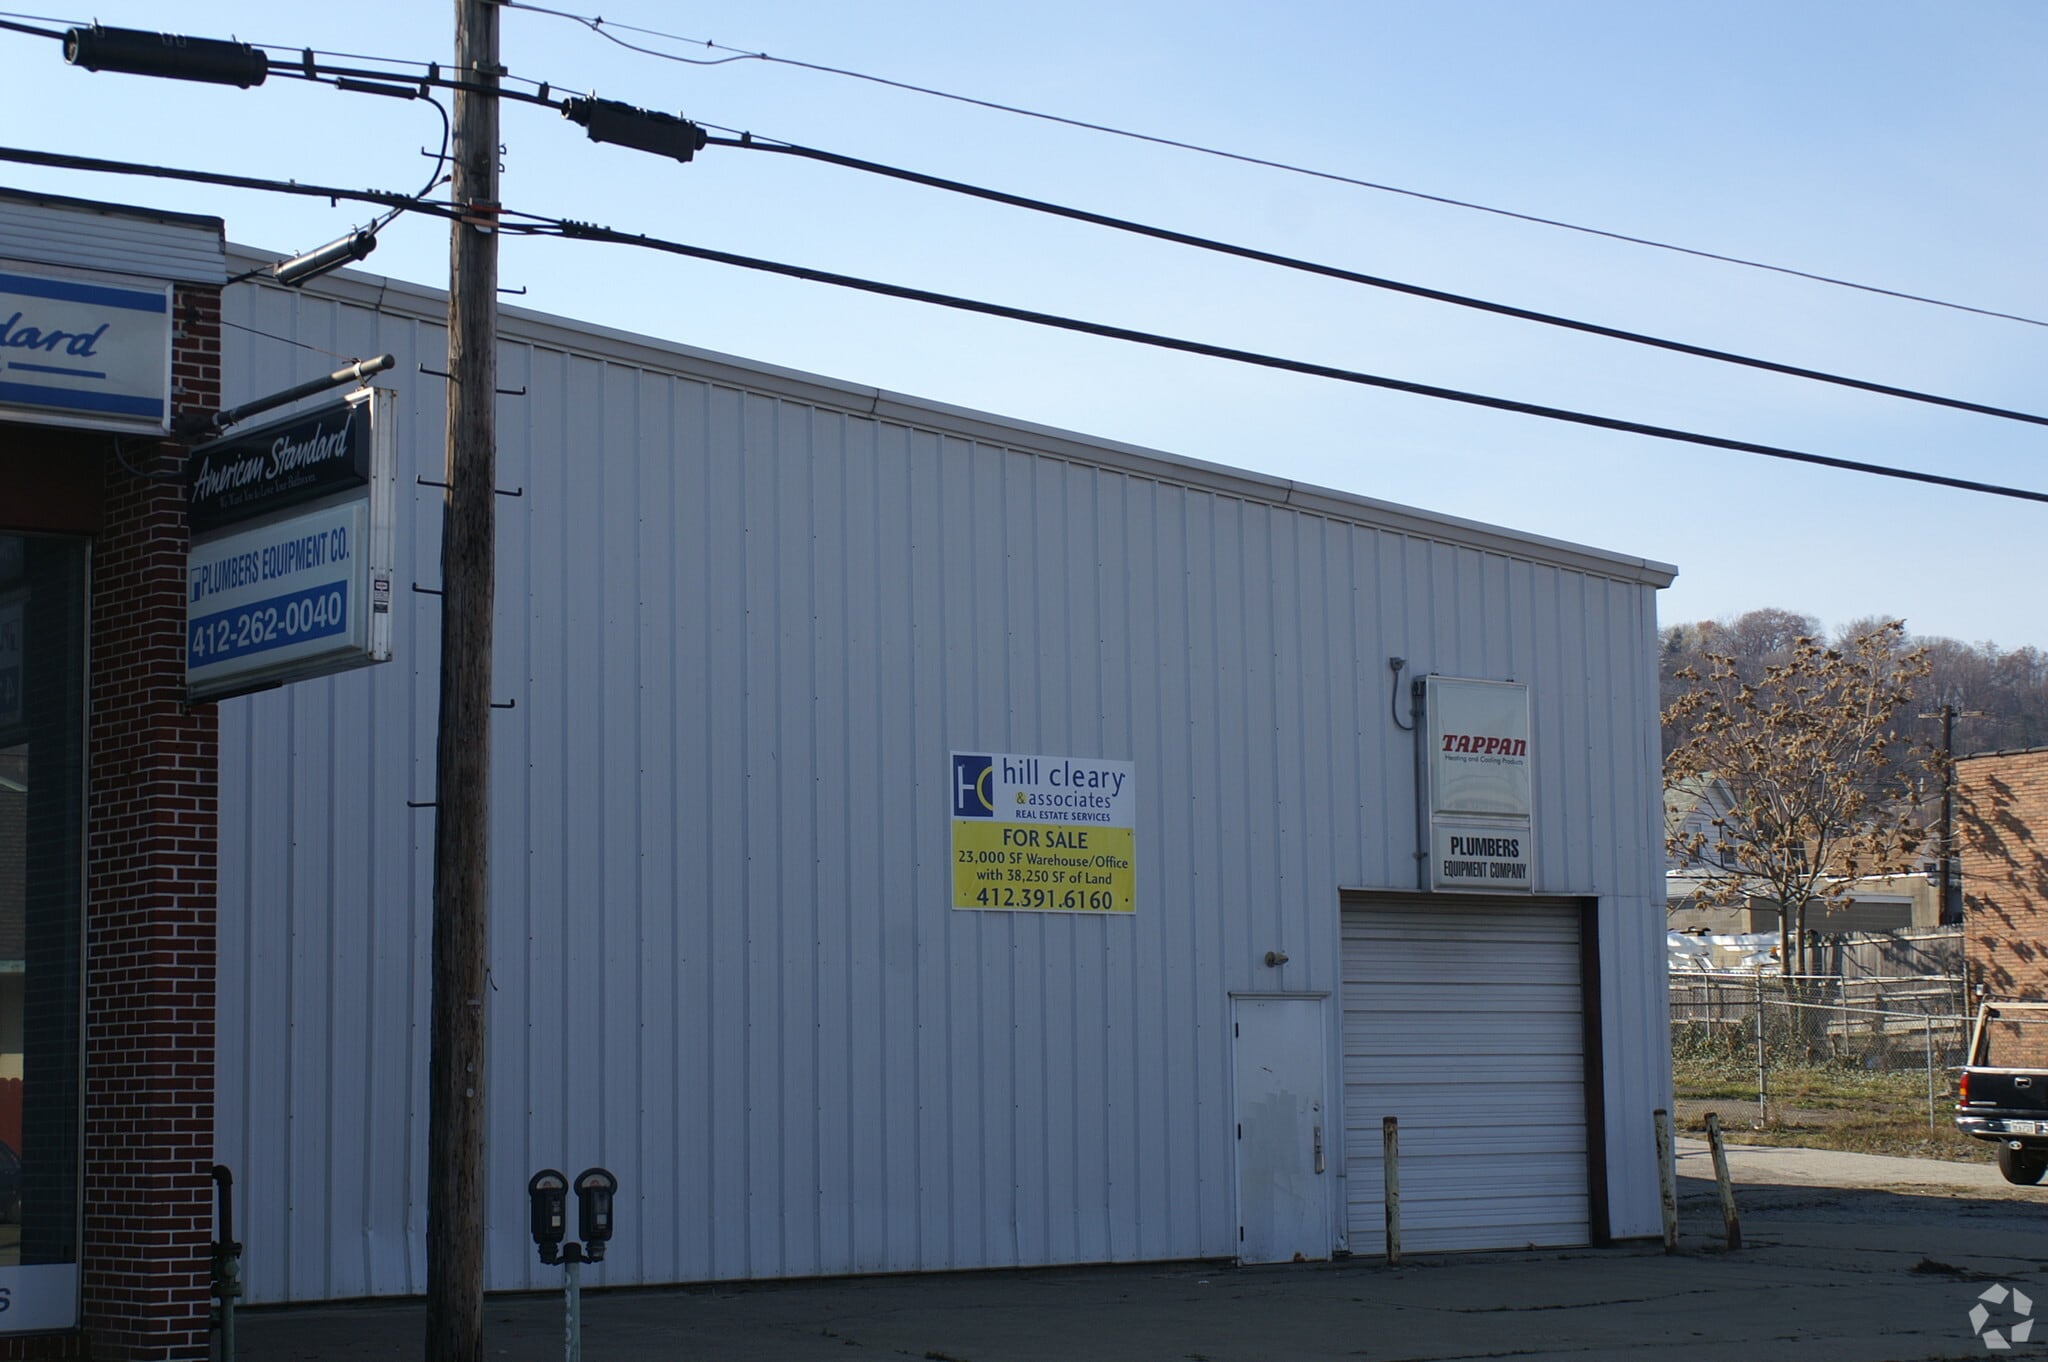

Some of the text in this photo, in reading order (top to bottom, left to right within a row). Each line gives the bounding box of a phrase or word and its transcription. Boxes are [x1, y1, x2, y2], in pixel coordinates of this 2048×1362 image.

[191, 453, 265, 504] American
[265, 413, 354, 480] Standard
[201, 526, 350, 597] PLUMBERS EQUIPMENT CO.
[192, 591, 342, 657] 412-262-0040
[1003, 757, 1126, 797] hill cleary
[1016, 790, 1111, 808] & associates
[1015, 809, 1111, 822] REAL ESTATE SERVICES
[1003, 828, 1089, 850] FOR SALE
[1451, 836, 1519, 858] PLUMBERS
[958, 850, 1128, 869] 23,000 SF Warehouse/Office
[1444, 860, 1527, 880] EQUIPMENT COMPANY
[976, 868, 1112, 885] with 38,250 SF of Land
[976, 887, 1112, 909] 412.391.6160
